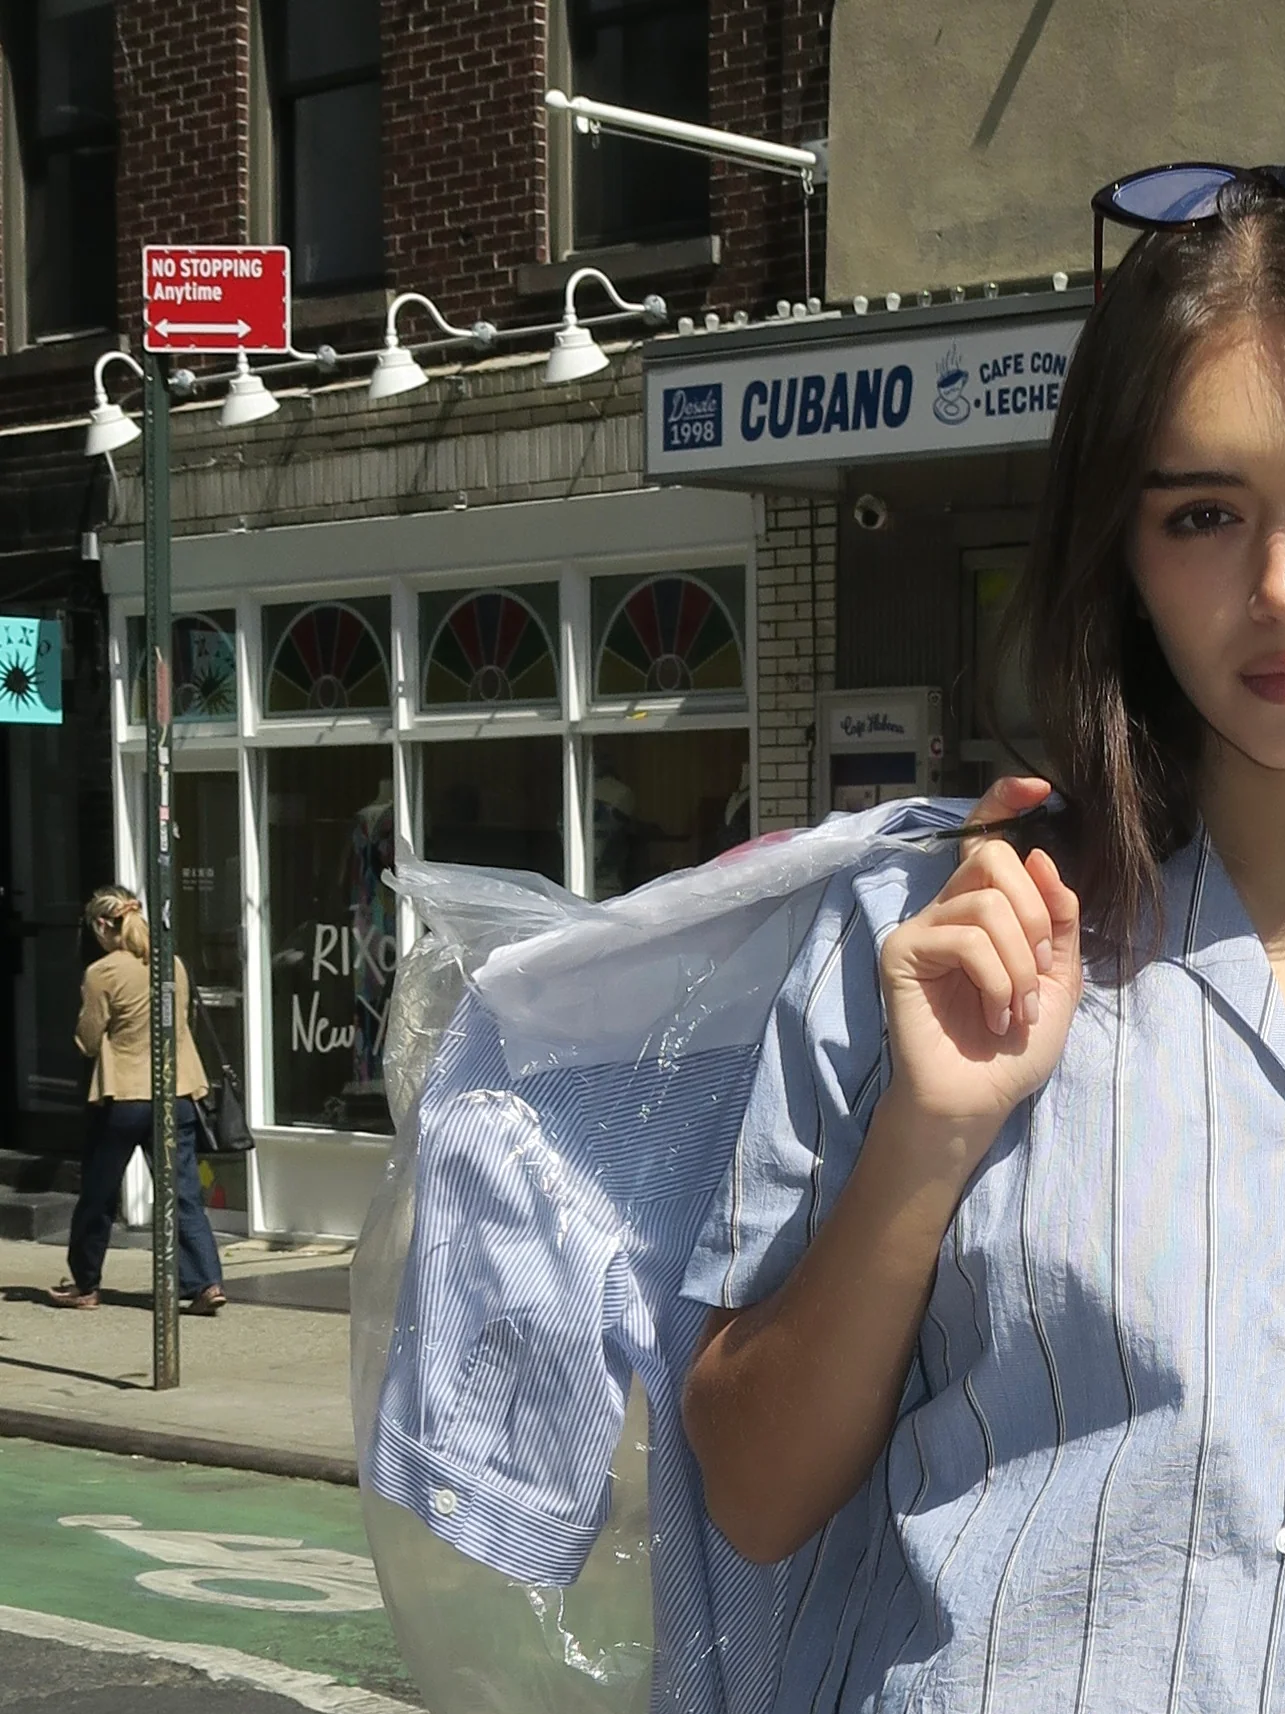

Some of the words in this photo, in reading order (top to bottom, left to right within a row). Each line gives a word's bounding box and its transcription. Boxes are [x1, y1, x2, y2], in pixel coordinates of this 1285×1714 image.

[152, 258, 176, 277] NO
[180, 258, 263, 277] STOPPING
[153, 281, 223, 305] Anytime
[979, 353, 1025, 384] CAFE
[1030, 351, 1068, 378] CON
[668, 389, 717, 423] Desde
[740, 364, 914, 442] CUBANO
[985, 383, 1060, 417] LECHE
[670, 420, 716, 445] 1998
[292, 991, 356, 1053] New
